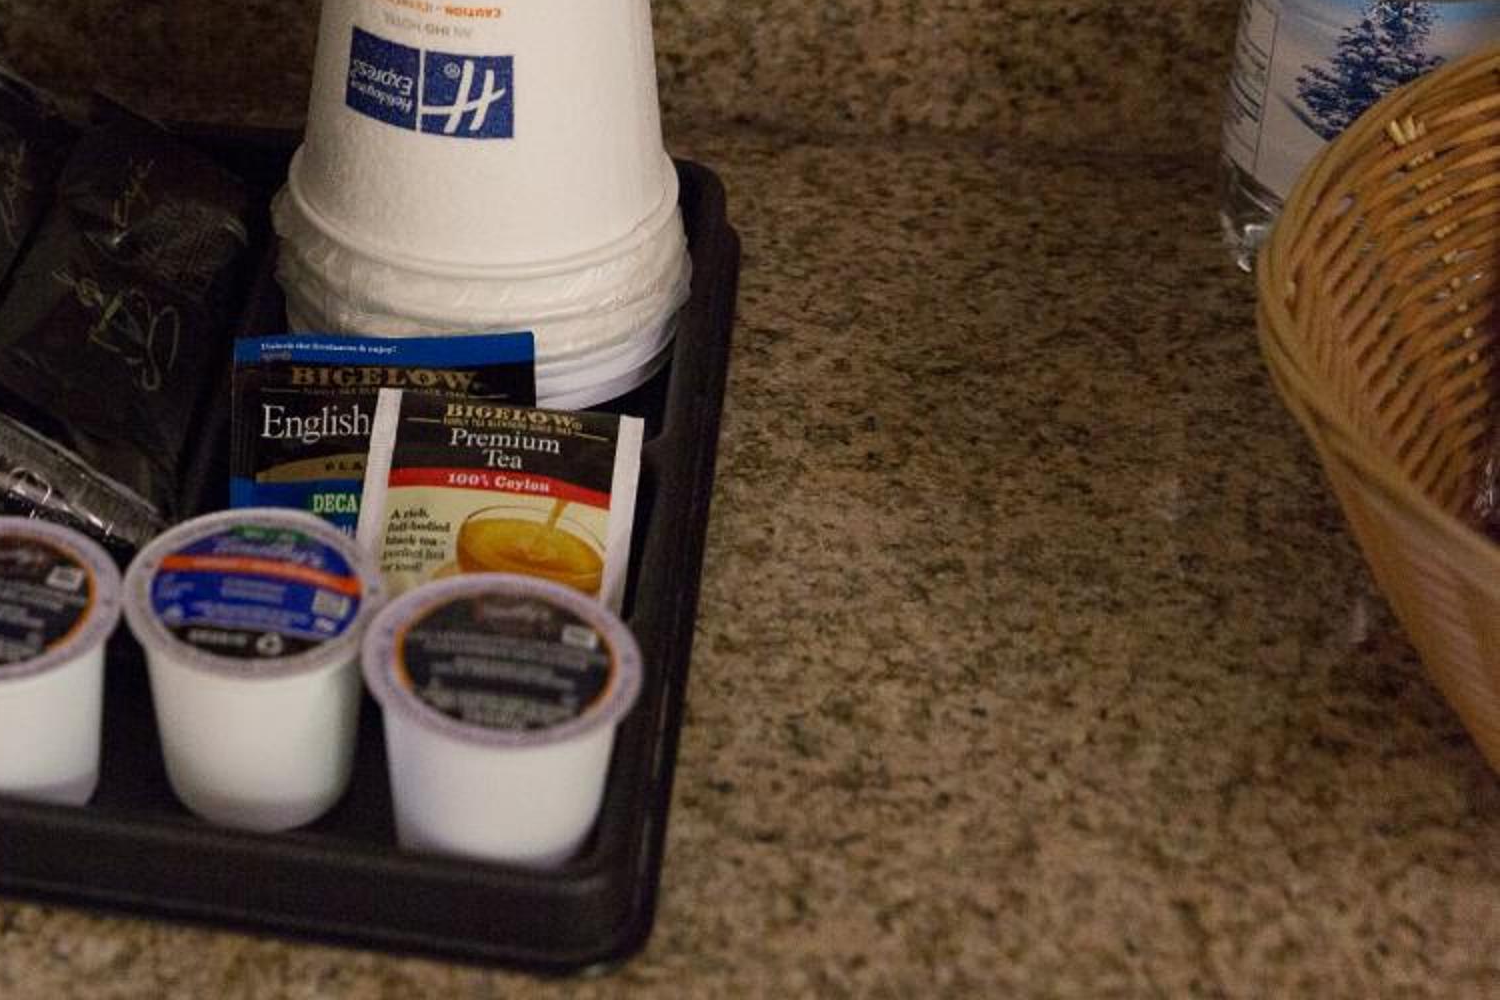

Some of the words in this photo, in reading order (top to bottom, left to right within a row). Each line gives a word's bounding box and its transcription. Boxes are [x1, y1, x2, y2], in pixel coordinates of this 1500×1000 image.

[445, 6, 502, 19] CAUTION
[350, 59, 413, 95] Express
[291, 365, 478, 389] BIGELOW
[260, 402, 370, 445] English
[445, 402, 575, 428] BIGELOW
[449, 427, 561, 455] Premium
[484, 450, 523, 470] Tea
[446, 472, 490, 488] 100%
[494, 474, 550, 493] Ceylon
[313, 492, 358, 513] DECA
